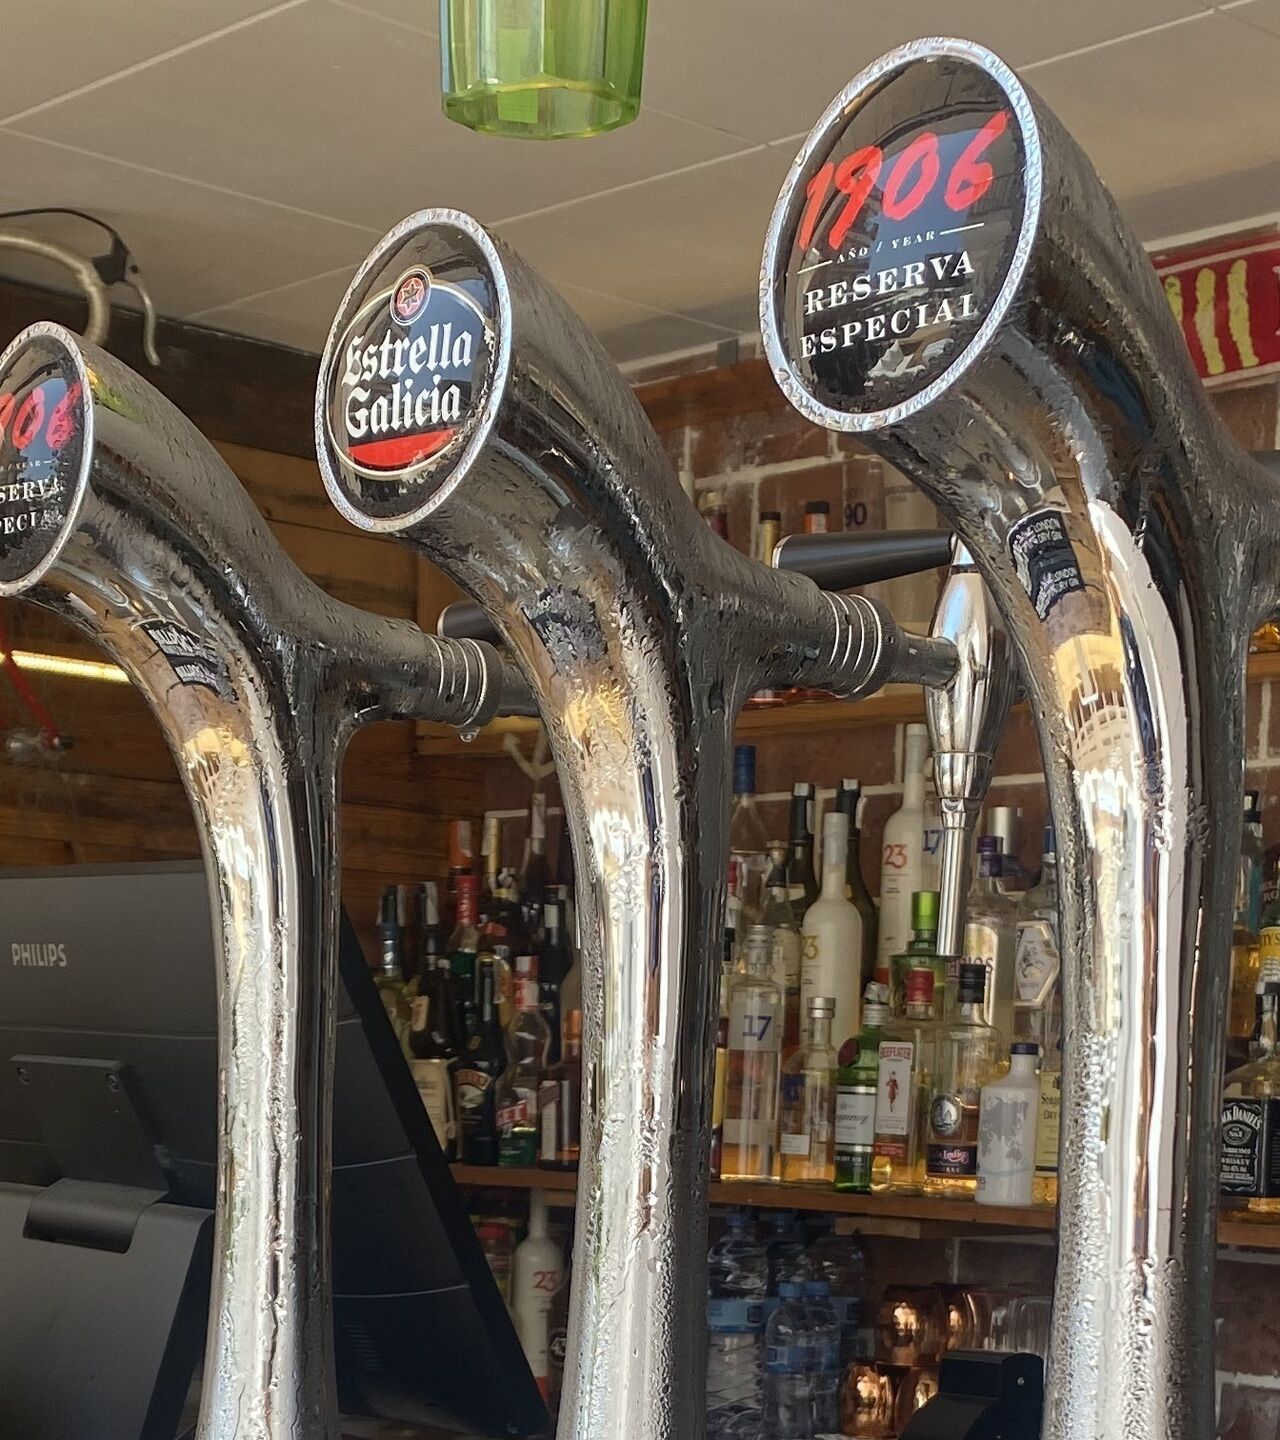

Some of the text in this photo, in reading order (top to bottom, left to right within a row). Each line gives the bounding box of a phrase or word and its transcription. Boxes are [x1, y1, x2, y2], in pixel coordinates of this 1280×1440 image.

[799, 110, 1012, 250] 1906
[837, 246, 869, 264] AÑO
[892, 230, 936, 249] YEAR
[804, 250, 976, 315] RESERVA
[800, 293, 978, 358] ESPECIAL
[341, 322, 473, 386] Estrella
[345, 374, 462, 438] Galicia
[883, 843, 908, 869] 23
[923, 830, 942, 855] 17
[11, 943, 67, 967] PHILIPS
[742, 1014, 772, 1042] 17
[879, 1047, 912, 1059] BEEFEATER
